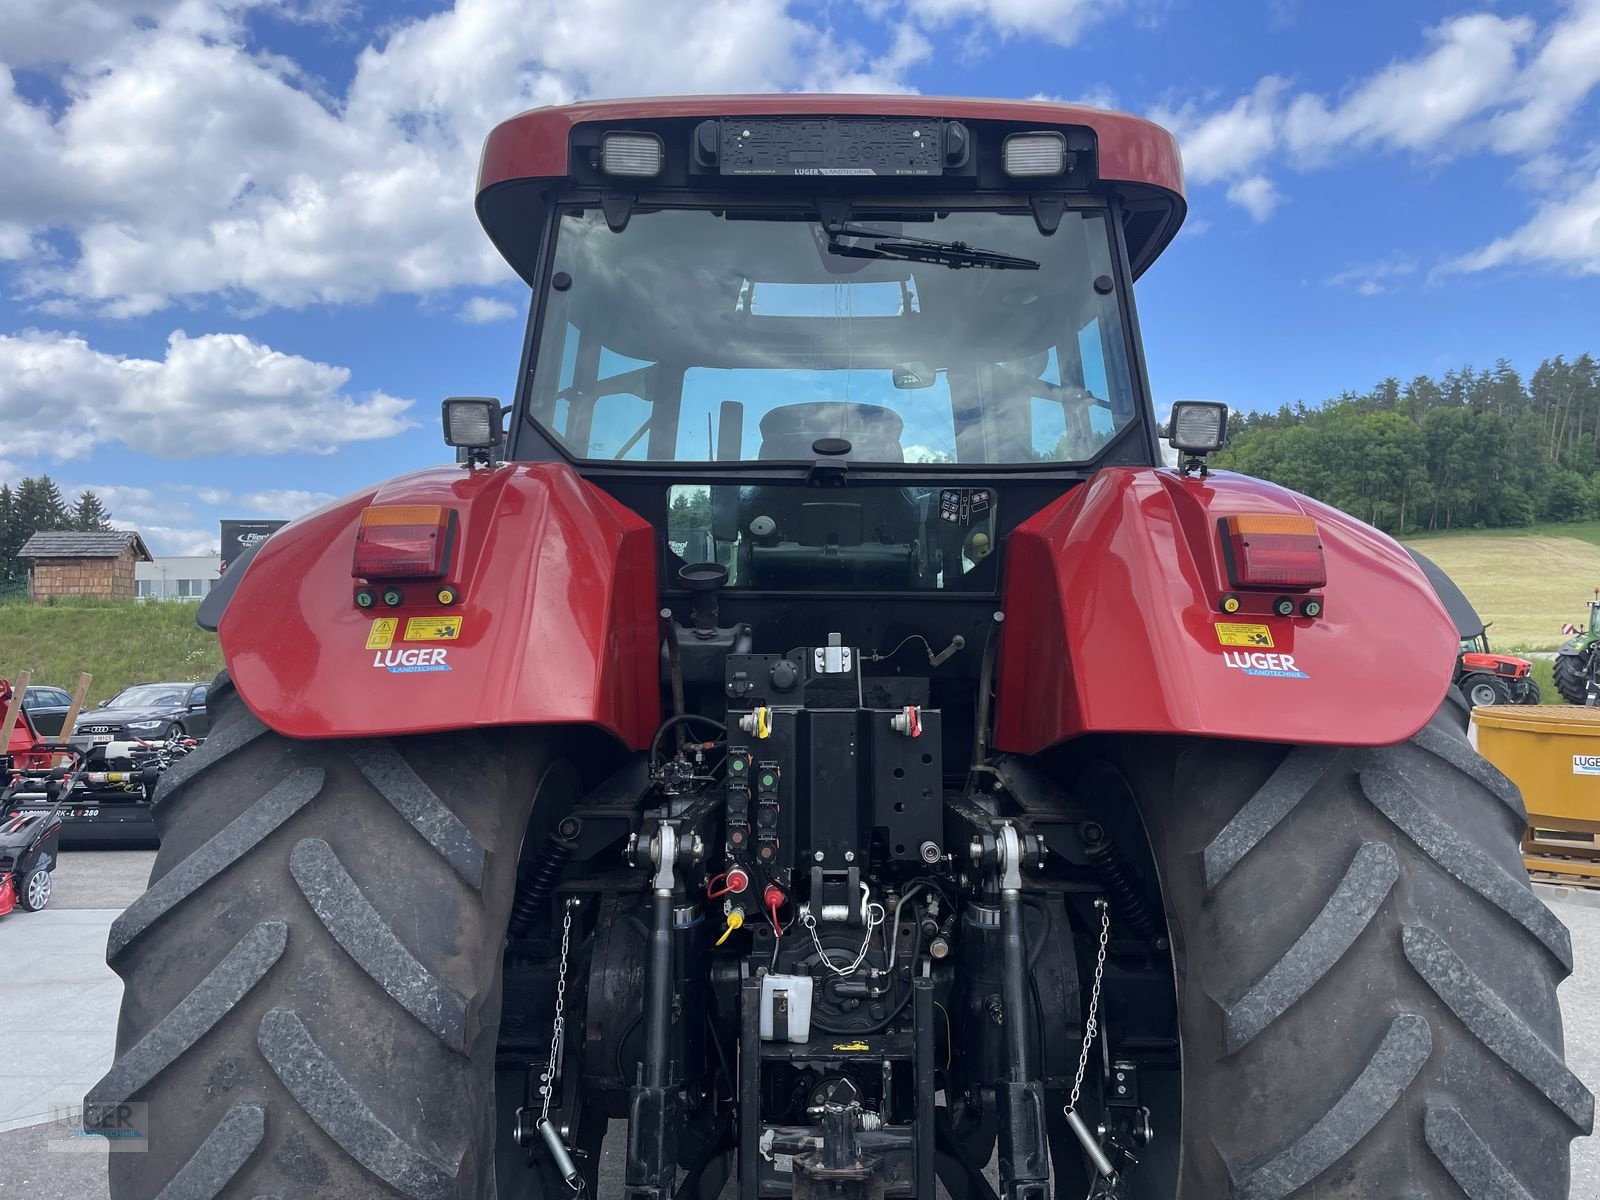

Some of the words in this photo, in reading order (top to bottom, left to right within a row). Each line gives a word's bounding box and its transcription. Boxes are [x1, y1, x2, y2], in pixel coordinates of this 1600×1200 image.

[373, 648, 448, 667] LUGER
[1223, 651, 1300, 671] LUGER
[392, 665, 446, 673] LANDTECHNIK
[83, 809, 99, 817] 280
